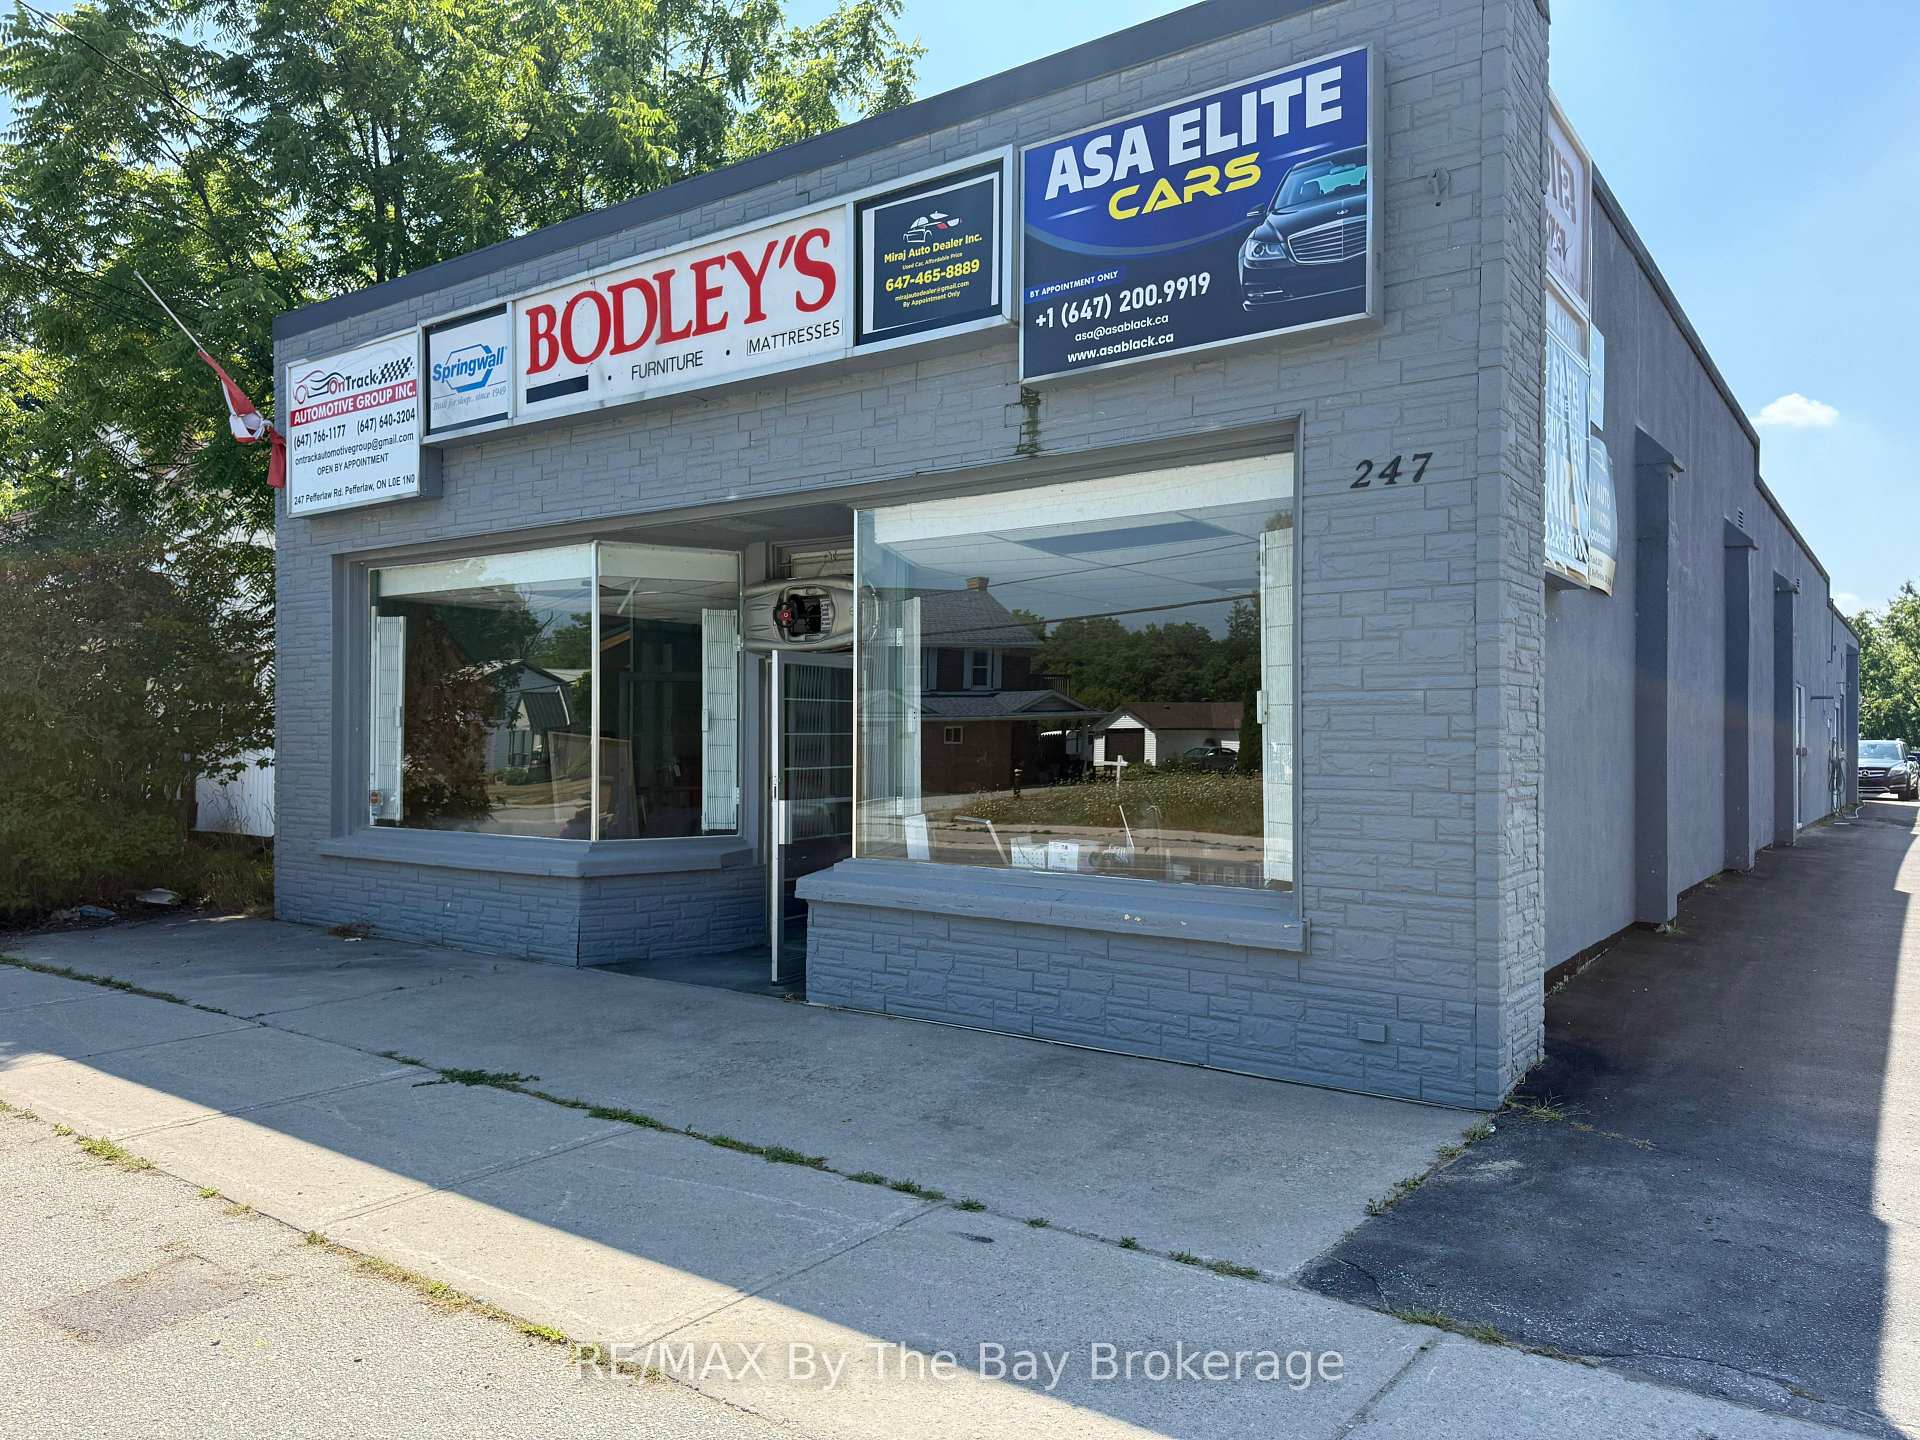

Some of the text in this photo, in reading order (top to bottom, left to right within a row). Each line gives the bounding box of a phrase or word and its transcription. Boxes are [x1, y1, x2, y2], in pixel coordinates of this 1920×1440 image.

[1044, 65, 1342, 201] ASA ELITE
[1108, 152, 1262, 220] CARS
[884, 233, 982, 263] Miraj Auto Dealer Inc.
[885, 259, 980, 292] 647-465-8889
[902, 262, 914, 270] Used
[911, 293, 946, 305] Appointment
[947, 291, 961, 299] Only
[1029, 270, 1119, 299] BY APPOINTMENT ONLY
[1035, 271, 1211, 329] +1 (647) 200.9919
[526, 228, 837, 375] BODLEY'S
[1075, 314, 1169, 342] asa@asablack.ca
[432, 346, 504, 383] Springwall
[631, 319, 840, 381] FURNITURE MATTRESSES
[1067, 333, 1174, 363] www.asablack.ca
[294, 382, 416, 424] AUTOMOTIVE GROUP INC.
[294, 408, 416, 451] (647) 766-1177 (647) 640-3204
[295, 432, 414, 465] ontrackautomotivegroup@gmail.com
[317, 453, 389, 476] OPEN BY APPOINTMENT
[1350, 452, 1433, 489] 247
[294, 496, 304, 505] 247
[305, 491, 332, 503] Pefferlaw
[334, 488, 344, 497] Rd.
[376, 480, 386, 489] ON
